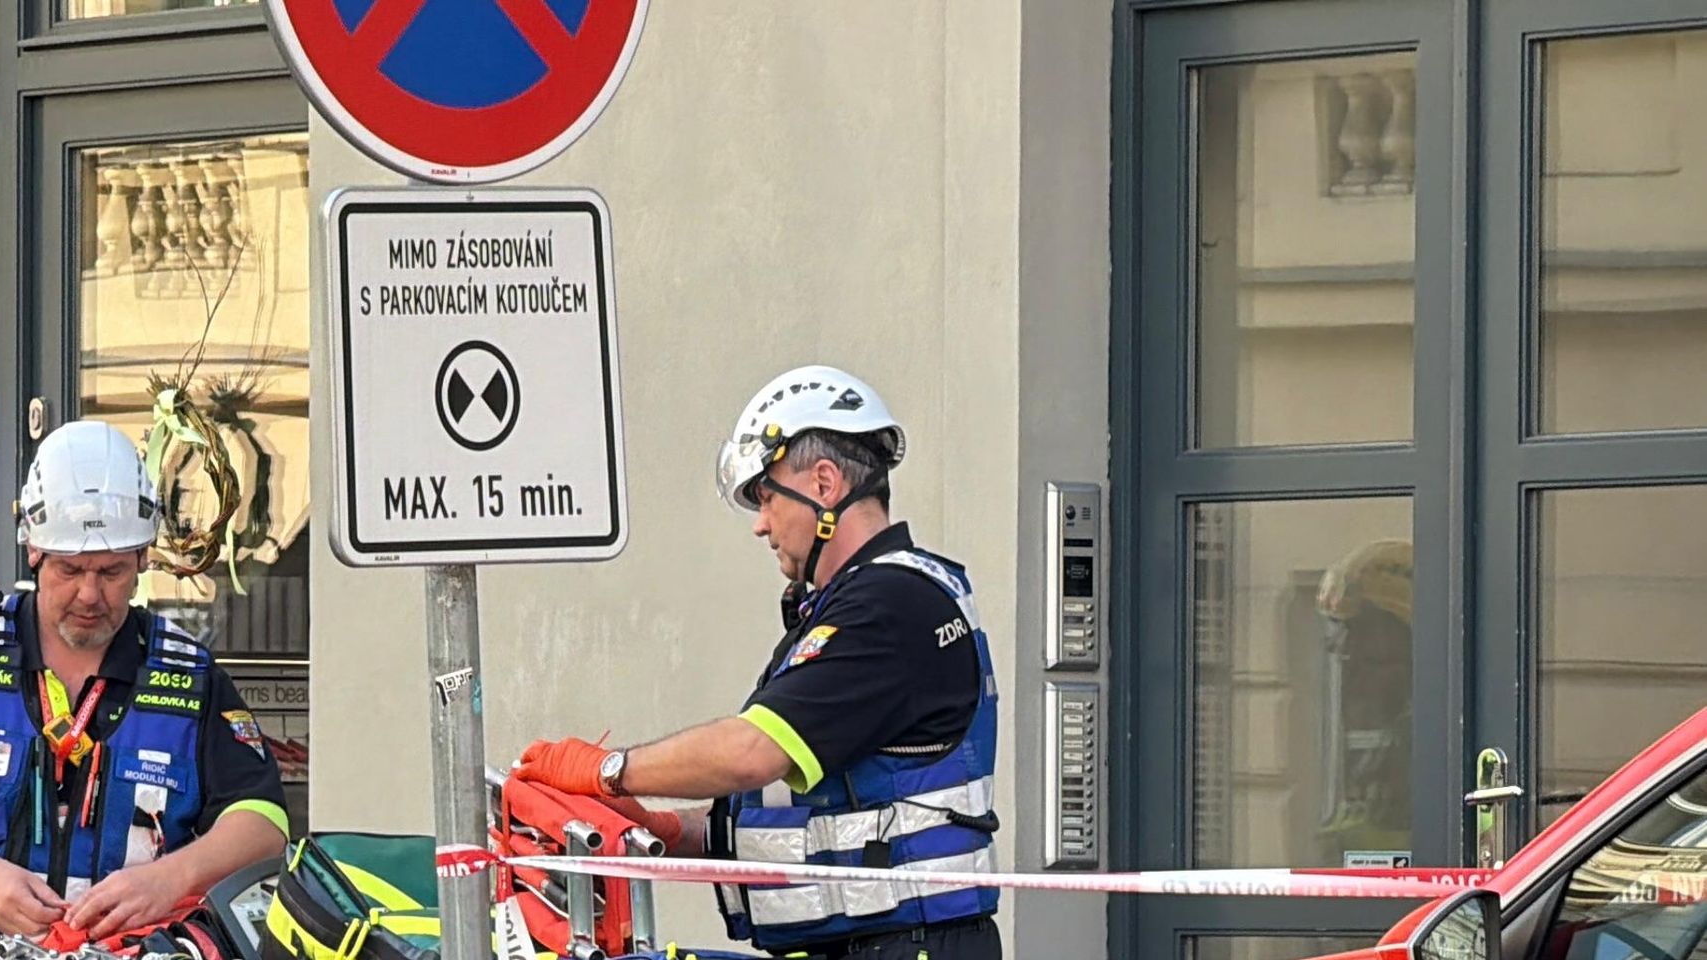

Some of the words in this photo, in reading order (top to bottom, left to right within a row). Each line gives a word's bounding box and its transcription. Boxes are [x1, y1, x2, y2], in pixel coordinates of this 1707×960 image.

[388, 238, 437, 270] MIMO
[445, 229, 554, 270] ZÁSOBOVÁNÍ
[360, 286, 372, 316] S
[379, 277, 488, 316] PARKOVACÍM
[496, 277, 588, 314] KOTOUČEM
[384, 476, 458, 520] MAX.
[472, 475, 503, 518] 15
[520, 473, 583, 517] min.
[275, 683, 309, 704] bea
[124, 769, 164, 784] MODULU
